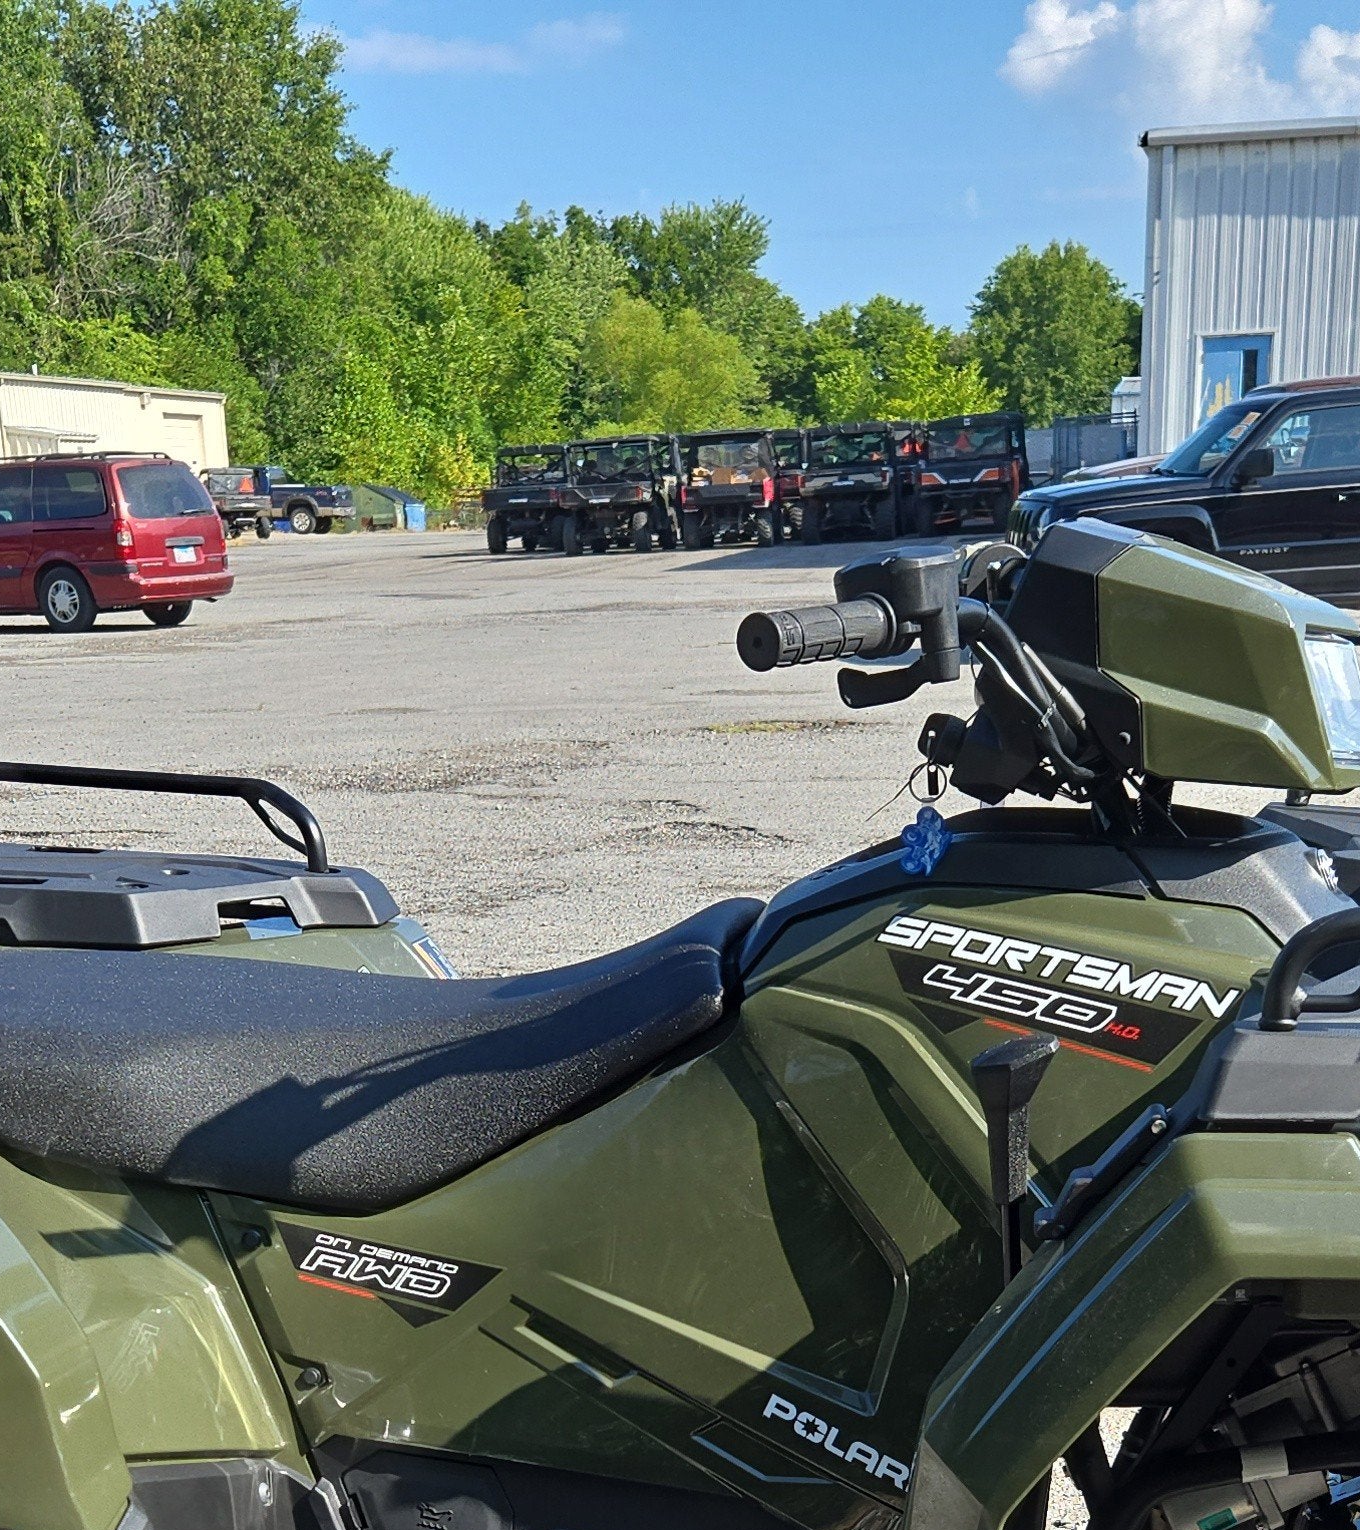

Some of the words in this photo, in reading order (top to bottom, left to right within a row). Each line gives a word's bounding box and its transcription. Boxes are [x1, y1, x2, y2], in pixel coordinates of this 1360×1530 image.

[877, 916, 1242, 1019] SPORTSMAN
[922, 963, 1118, 1034] 450
[300, 1245, 451, 1299] AWD
[315, 1233, 351, 1249] ON
[359, 1242, 459, 1274] DEMAND
[762, 1393, 918, 1492] POLAR
